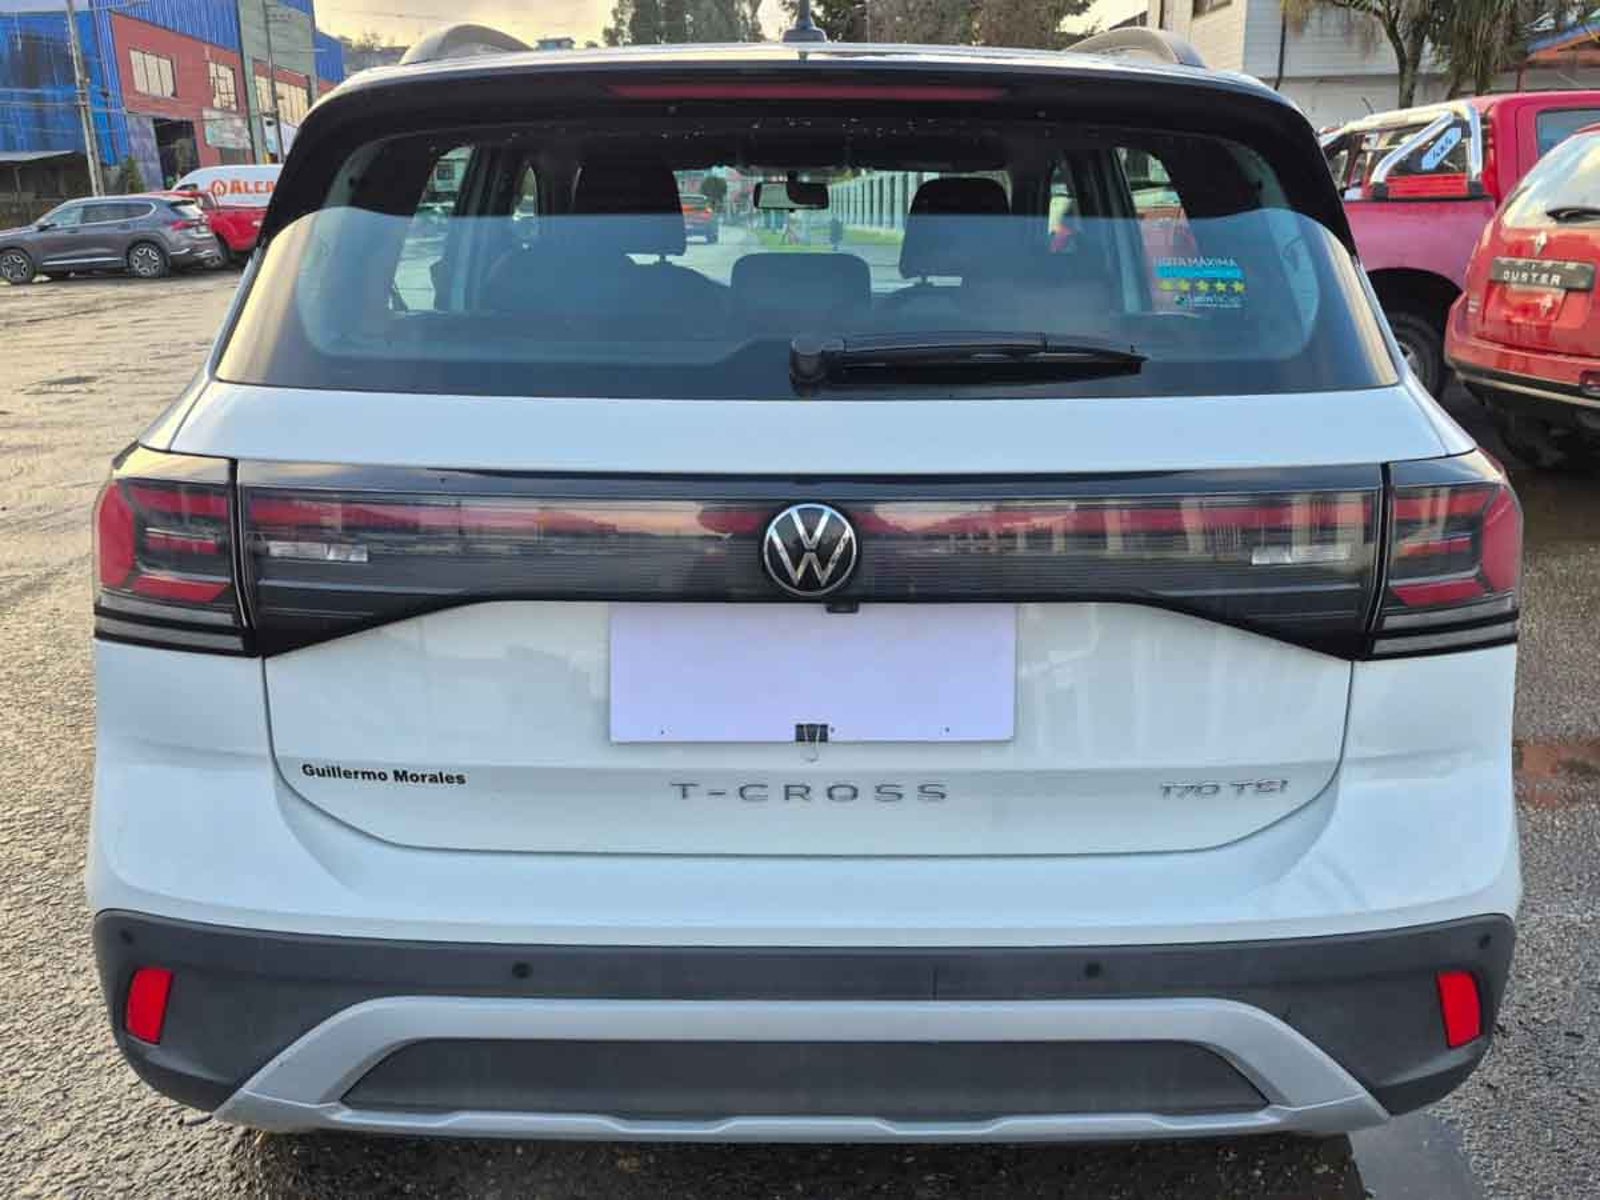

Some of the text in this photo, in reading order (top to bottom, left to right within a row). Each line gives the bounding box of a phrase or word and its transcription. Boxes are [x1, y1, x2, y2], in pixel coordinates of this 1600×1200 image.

[1503, 269, 1561, 286] DUSTER
[301, 763, 467, 785] Guillermo Morales
[669, 782, 948, 802] T-CROSS
